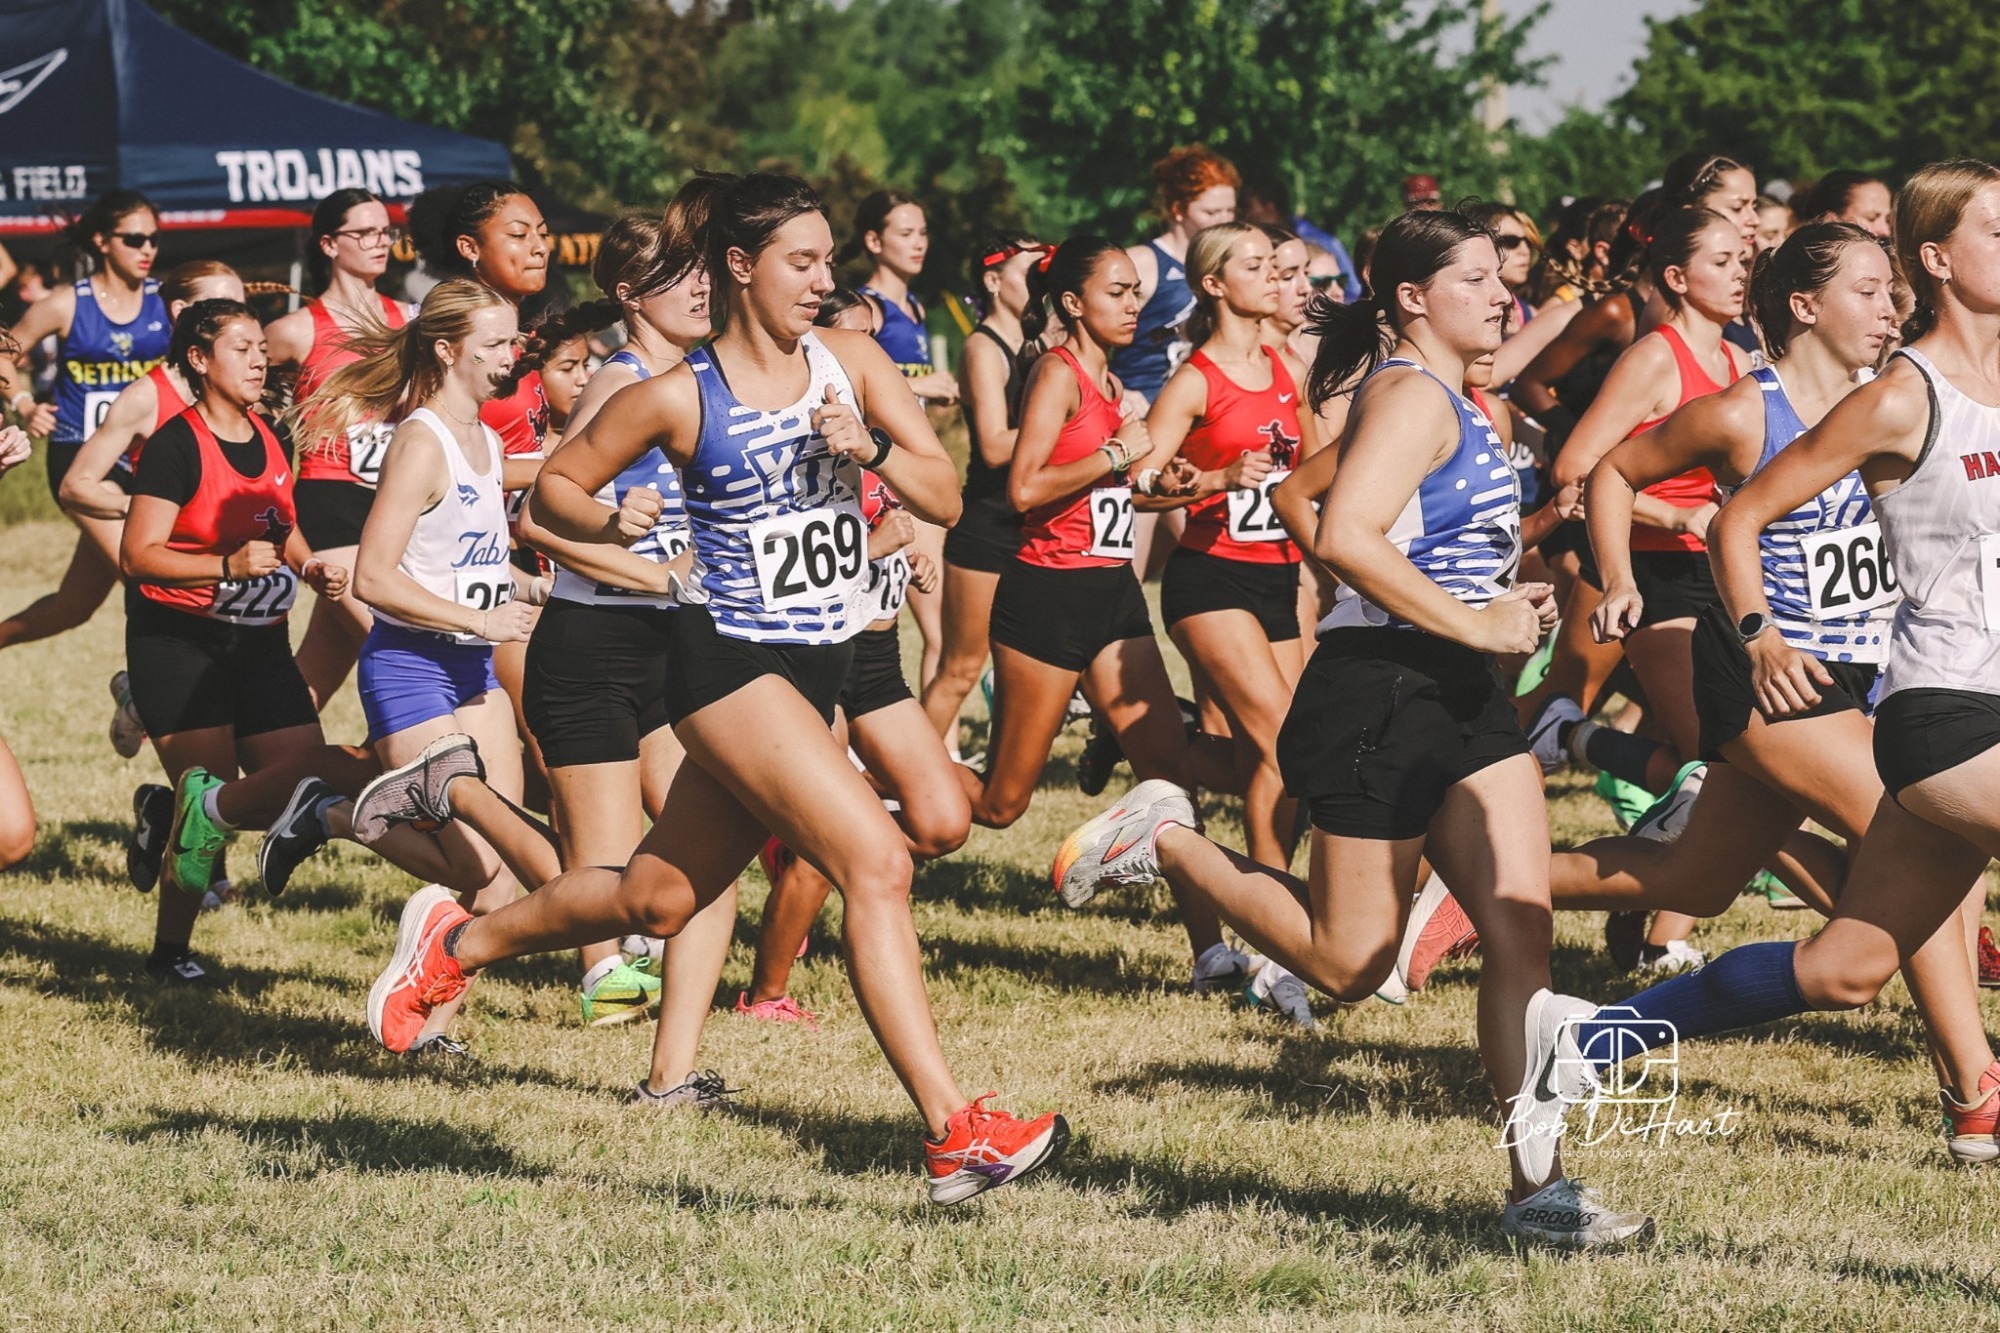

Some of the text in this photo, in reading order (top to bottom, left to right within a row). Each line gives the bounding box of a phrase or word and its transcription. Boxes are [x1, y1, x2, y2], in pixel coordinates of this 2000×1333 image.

[12, 164, 87, 200] FIELD
[215, 147, 426, 202] TROJANS
[1960, 449, 2000, 482] HA
[1098, 497, 1136, 549] 22
[1237, 481, 1291, 533] 22
[451, 530, 510, 569] Tab
[763, 512, 862, 599] 269
[1814, 535, 1899, 609] 266
[215, 572, 293, 618] 222
[1519, 1206, 1600, 1228] BROOKS
